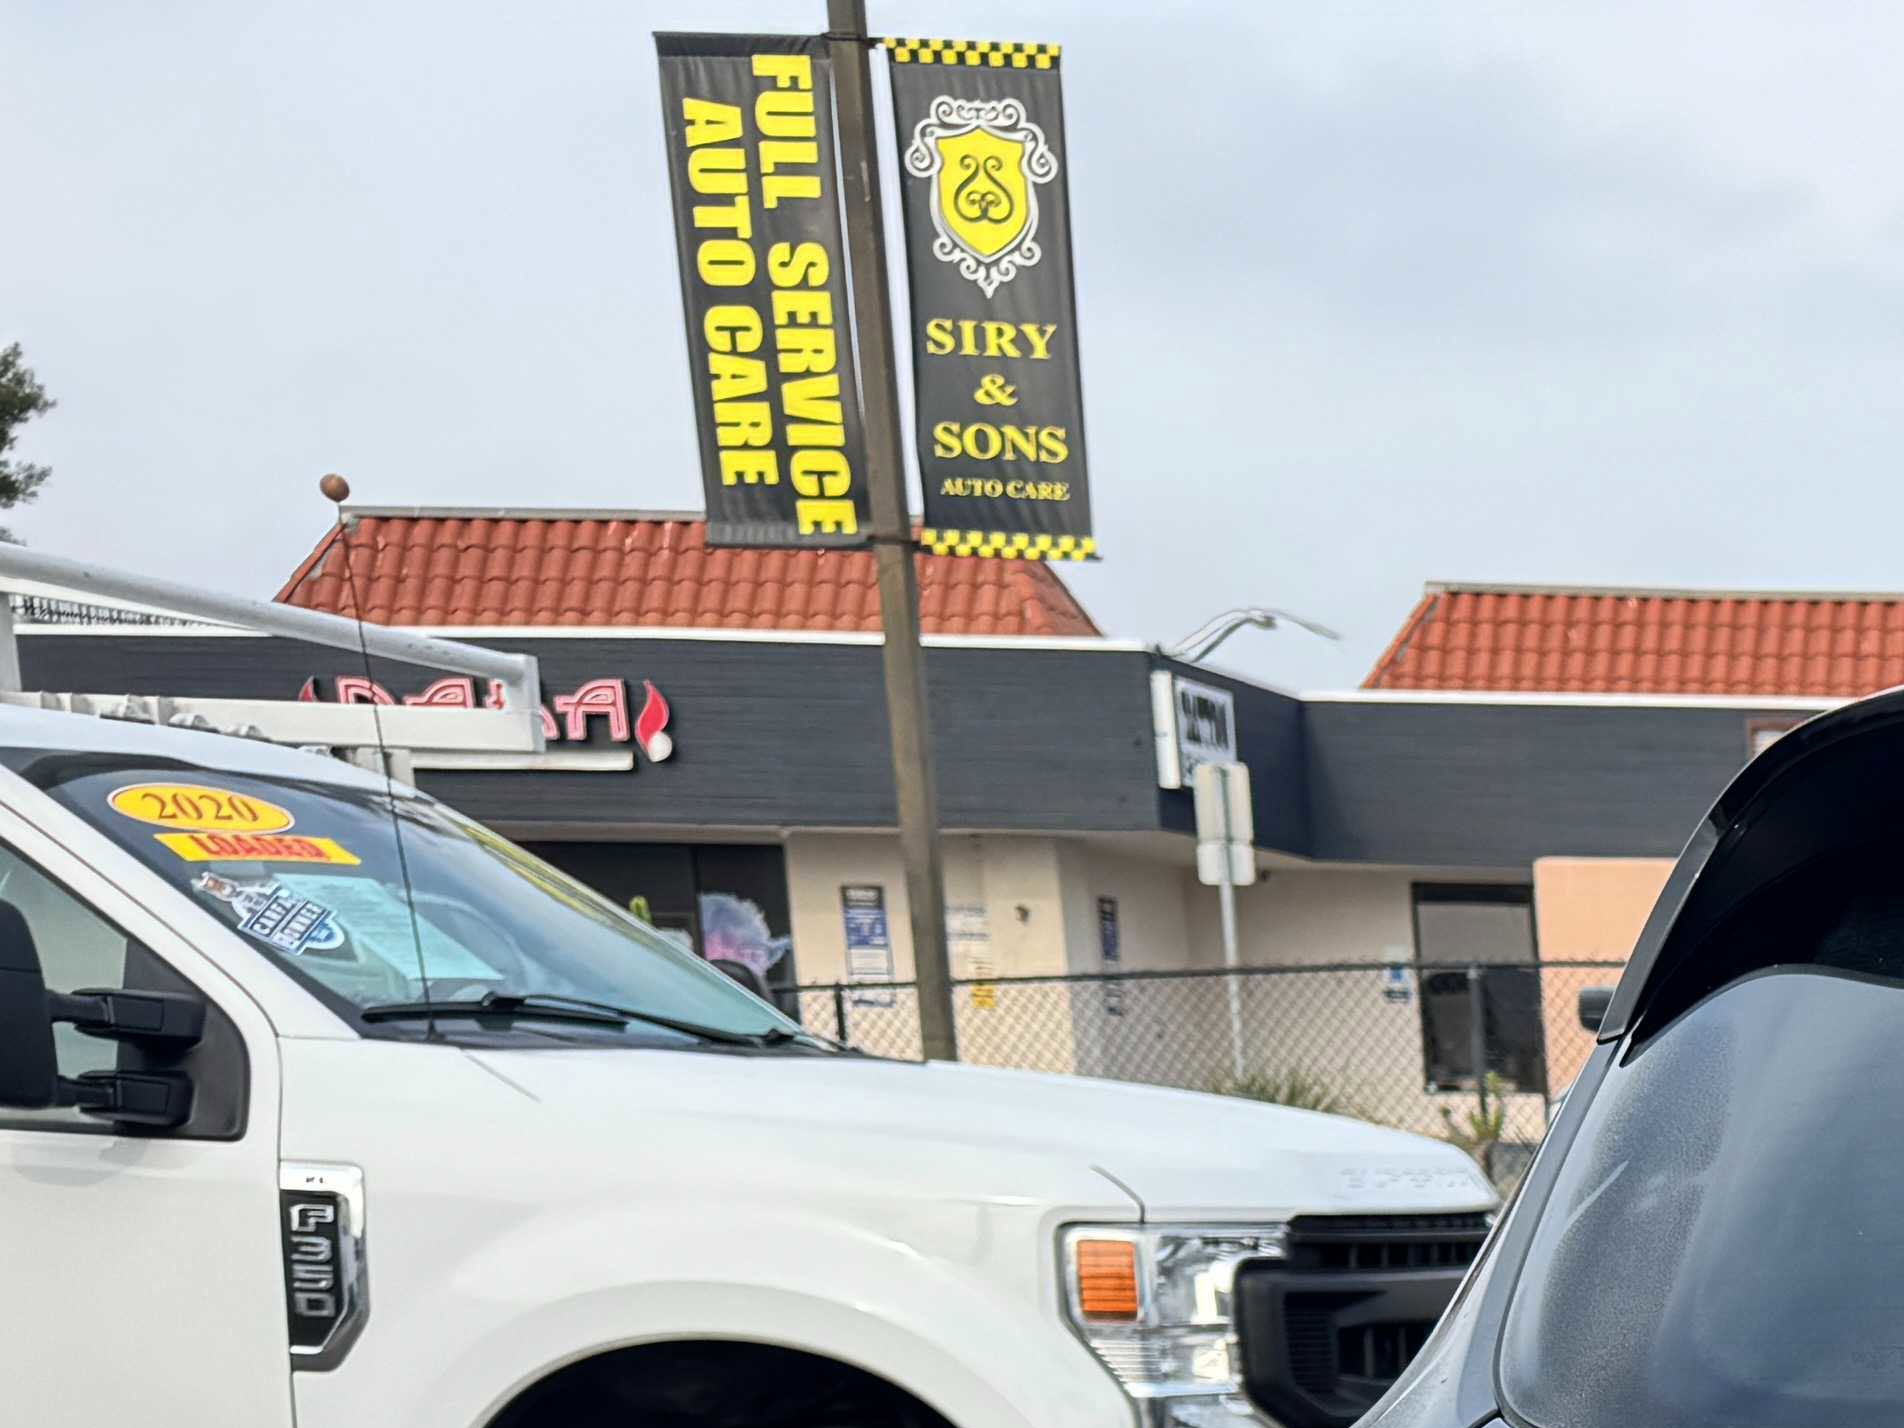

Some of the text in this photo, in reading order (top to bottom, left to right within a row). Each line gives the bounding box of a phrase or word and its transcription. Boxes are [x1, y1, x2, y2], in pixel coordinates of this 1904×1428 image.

[682, 97, 779, 487] AUTO CARE
[751, 53, 859, 536] FULL SERVICE
[925, 317, 1058, 361] SIRY
[974, 373, 1019, 407] &
[933, 421, 1069, 465] SONS
[940, 476, 1071, 502] AUTO CARE
[140, 791, 260, 823] 2020
